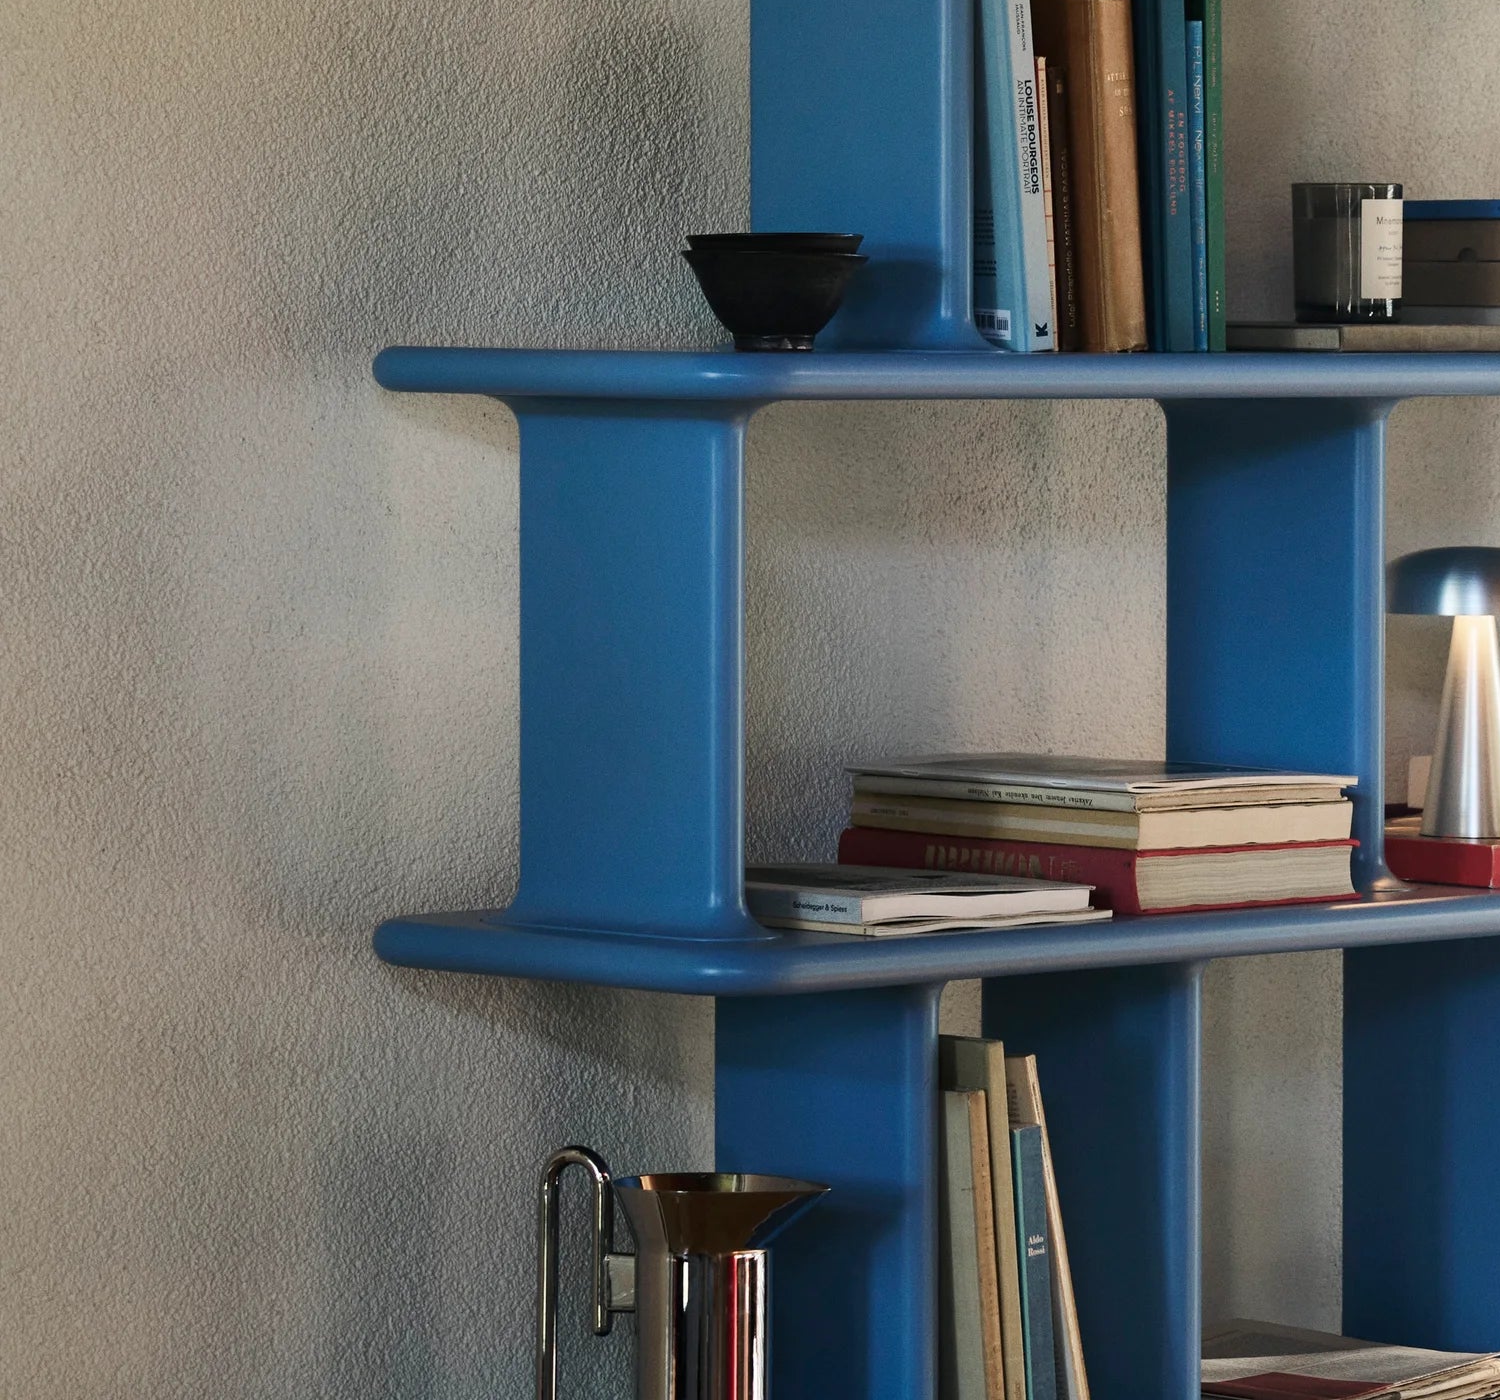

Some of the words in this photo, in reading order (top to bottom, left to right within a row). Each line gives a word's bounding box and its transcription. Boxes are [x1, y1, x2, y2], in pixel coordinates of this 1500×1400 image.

[1016, 80, 1025, 94] AN
[1024, 80, 1036, 123] LOUISE
[1018, 96, 1029, 144] INTIMATE
[1021, 147, 1033, 195] PORTRAIT
[1027, 124, 1040, 195] BOURGEOIS
[792, 901, 824, 912] Scheidegger
[830, 904, 848, 913] Spiess
[1028, 1234, 1044, 1245] Aldo
[1028, 1245, 1045, 1257] Rossi
